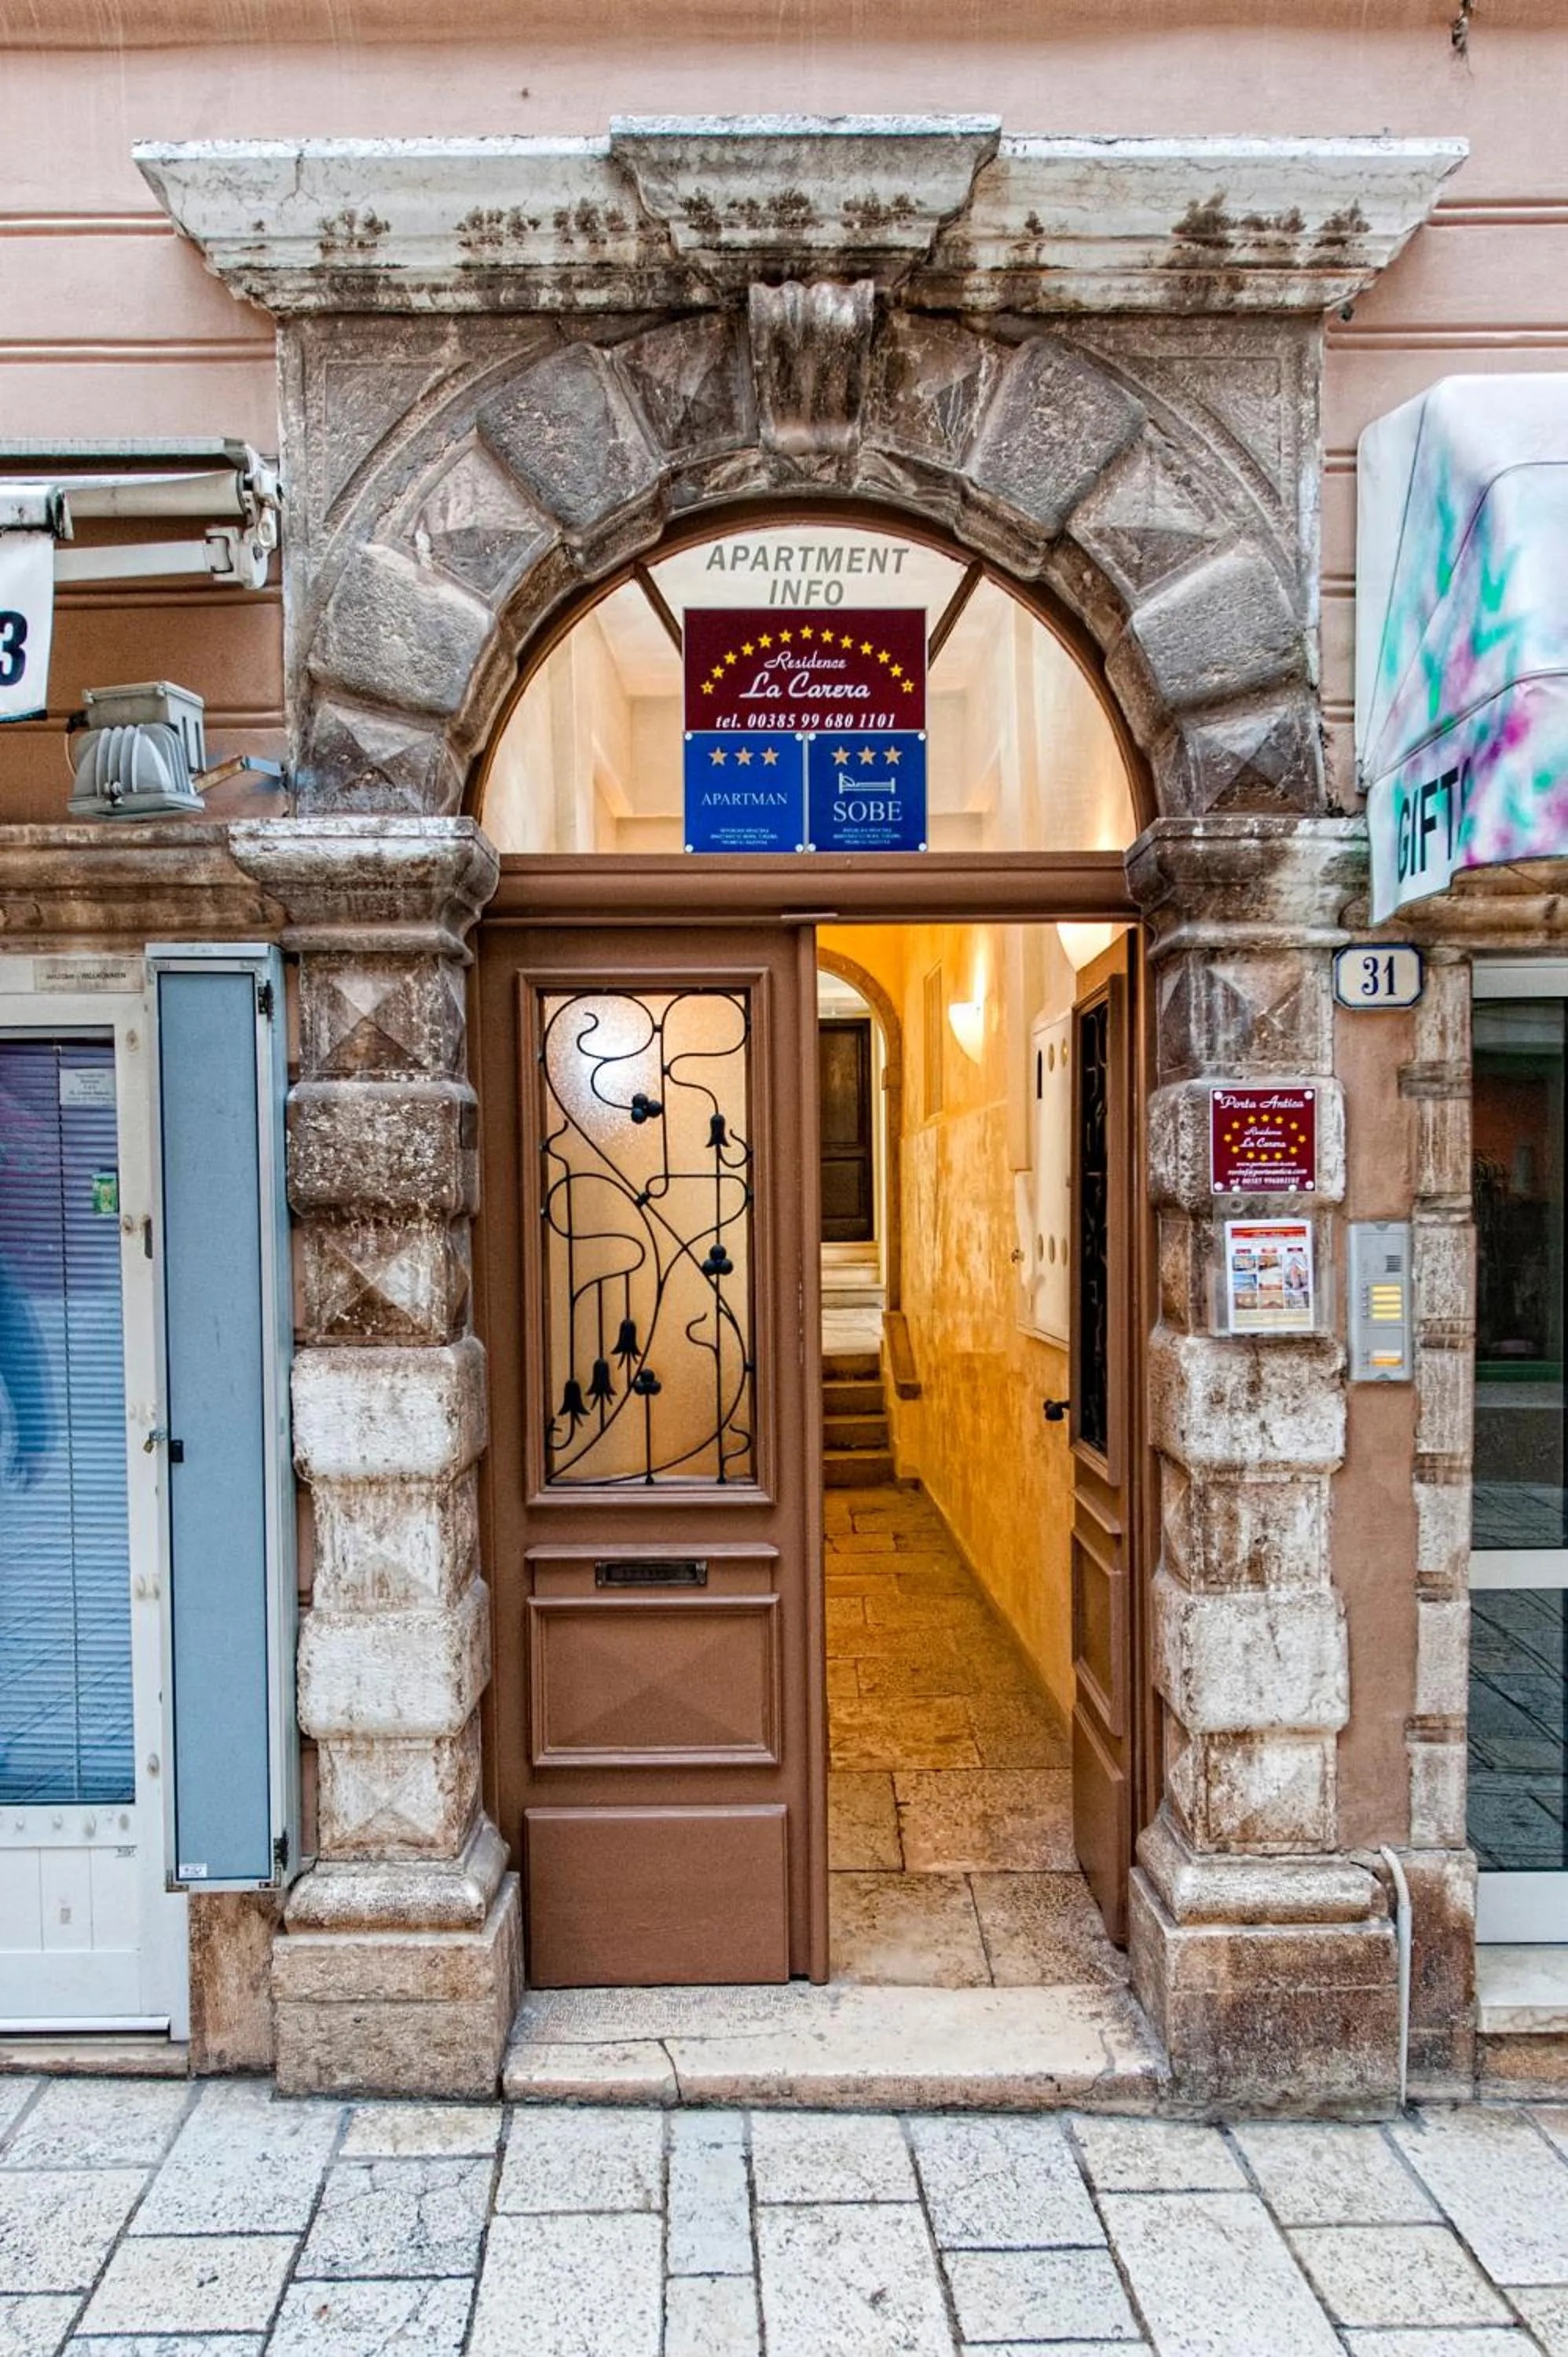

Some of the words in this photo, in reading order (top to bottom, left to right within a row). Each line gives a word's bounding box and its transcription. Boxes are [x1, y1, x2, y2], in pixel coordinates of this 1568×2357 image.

[706, 544, 910, 574] APARTMENT
[769, 578, 844, 606] INFO
[764, 651, 848, 670] Residence
[738, 672, 782, 698] La
[788, 672, 870, 698] Carera
[716, 713, 742, 728] tel.
[747, 713, 795, 728] 00385
[800, 713, 821, 728] 99
[824, 713, 854, 728] 680
[859, 713, 896, 728] 1101
[701, 793, 788, 806] APARTMAN
[833, 801, 903, 823] SOBE
[1361, 955, 1396, 996] 31
[1219, 1095, 1256, 1109] Porta
